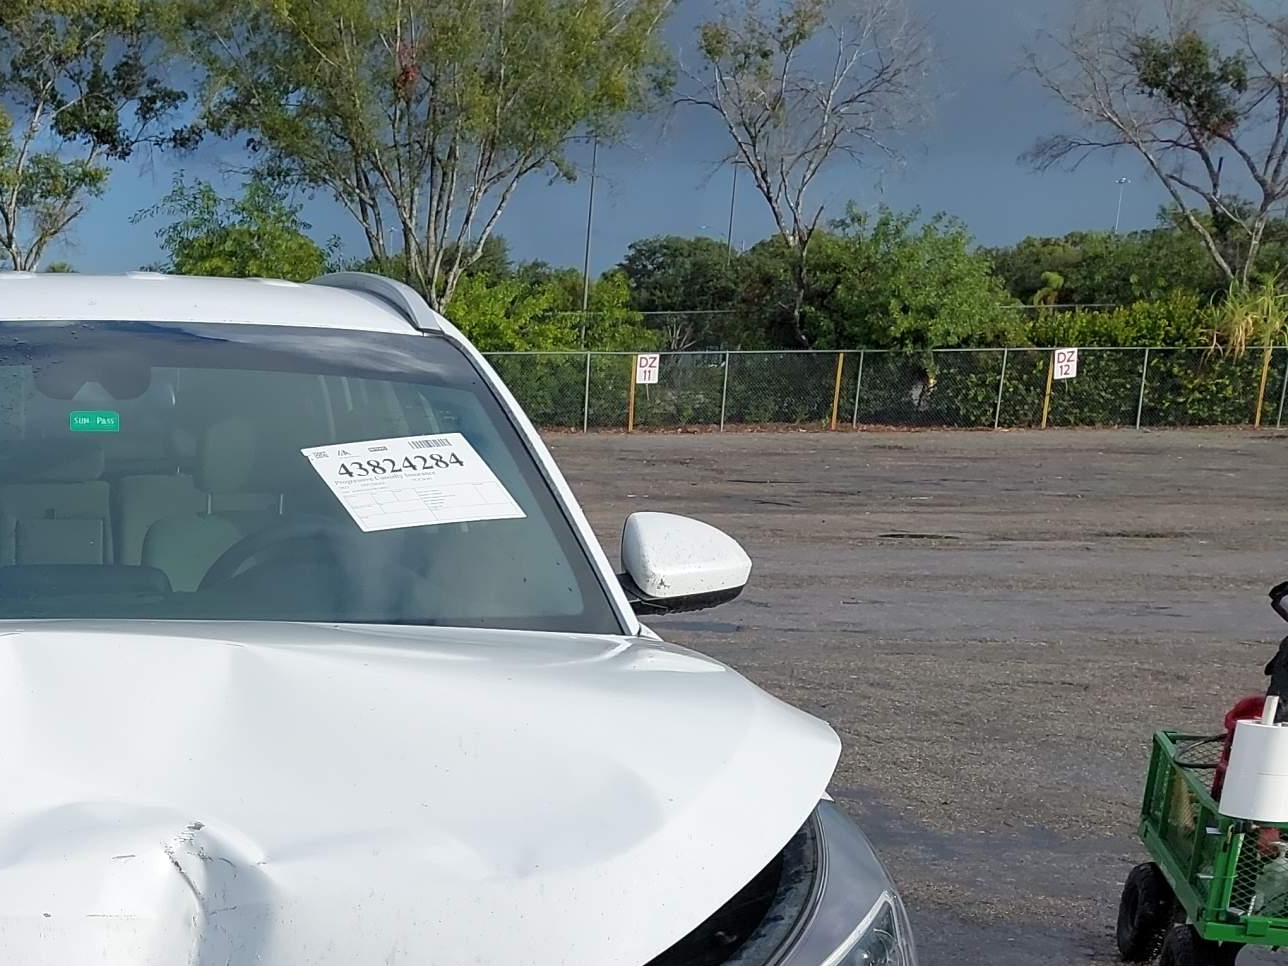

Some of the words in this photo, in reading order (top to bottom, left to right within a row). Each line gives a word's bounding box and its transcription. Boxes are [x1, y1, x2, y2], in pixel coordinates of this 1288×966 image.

[639, 356, 657, 368] DZ
[1057, 351, 1075, 363] DZ
[643, 370, 651, 381] 11
[1059, 364, 1070, 376] 12
[338, 452, 464, 477] 43824284
